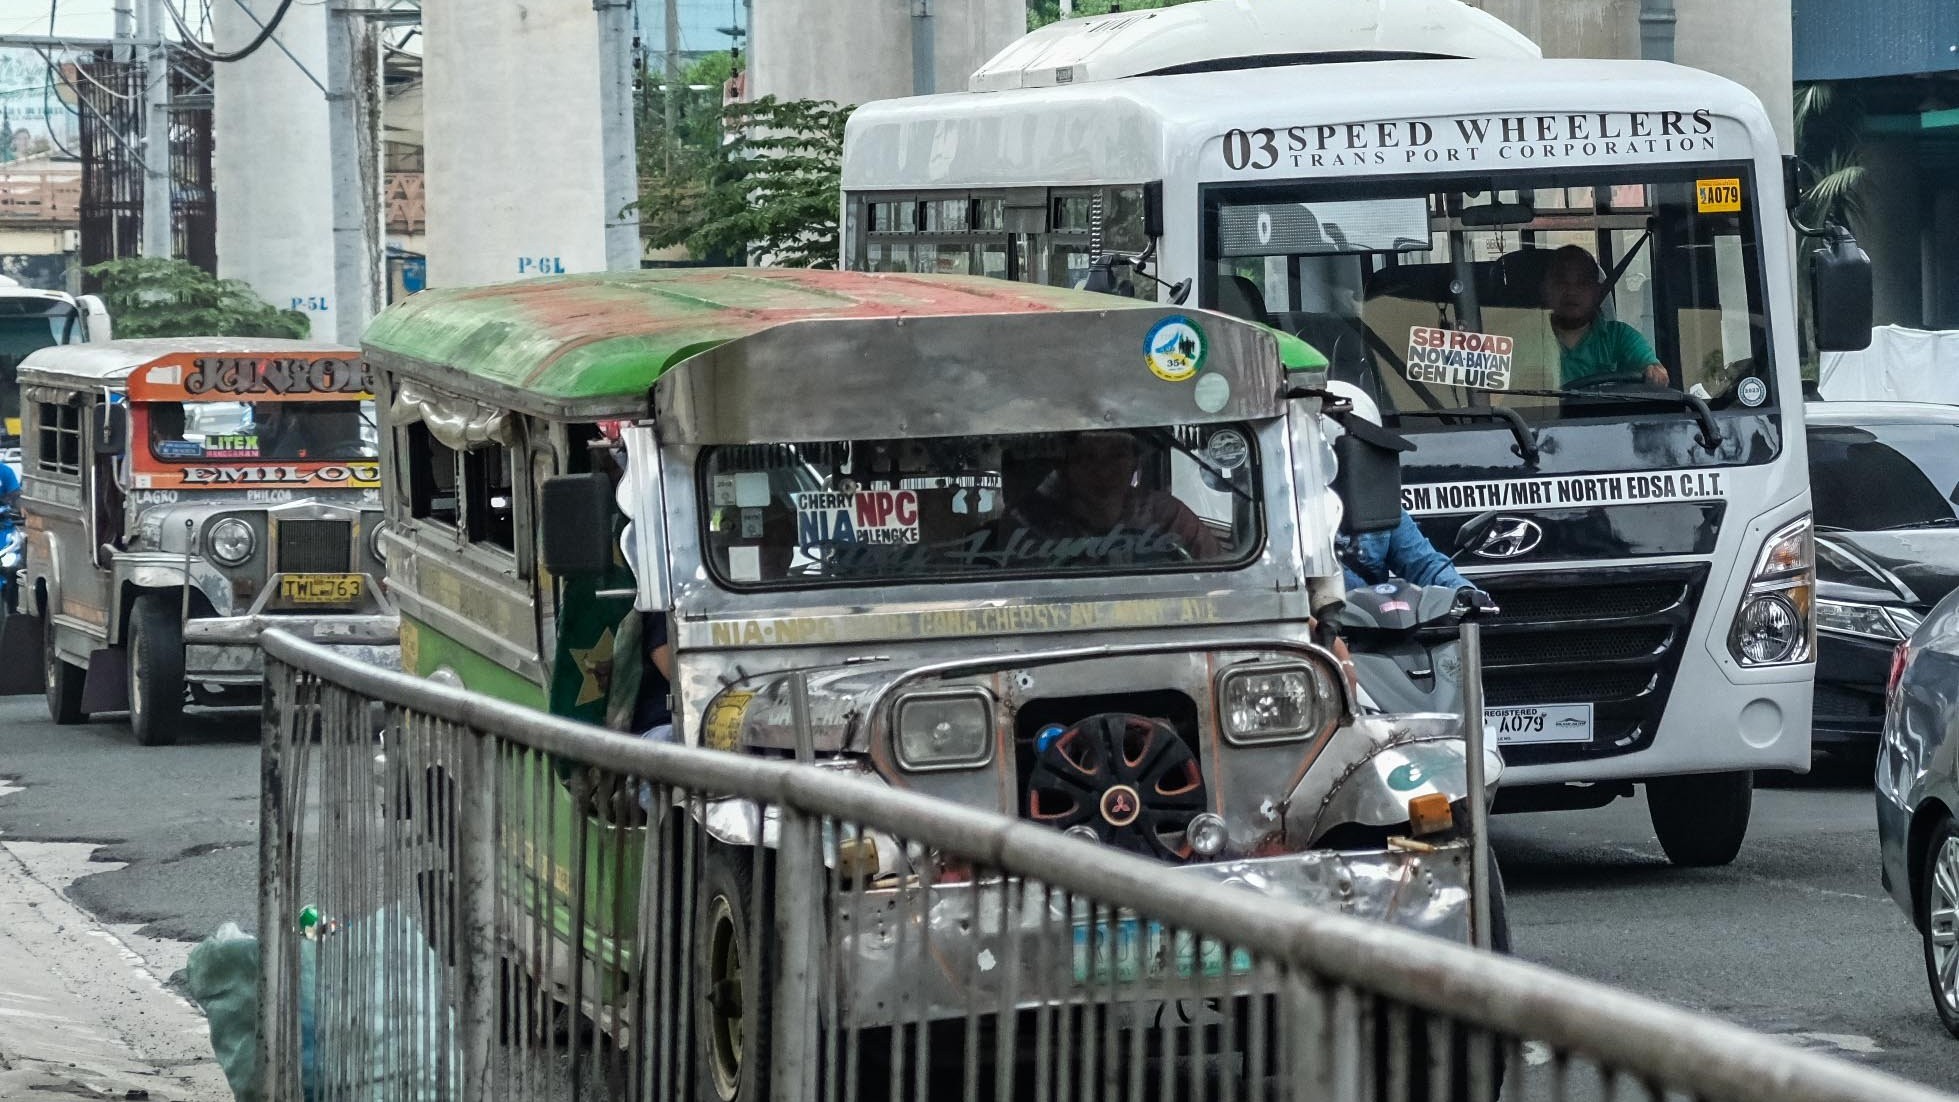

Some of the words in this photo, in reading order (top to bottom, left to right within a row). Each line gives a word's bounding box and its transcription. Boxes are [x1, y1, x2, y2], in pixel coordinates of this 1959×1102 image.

[1287, 121, 1433, 152] SPEED
[1454, 108, 1712, 145] WHEELERS
[1222, 127, 1279, 171] 03
[1290, 151, 1386, 168] TRANS
[1405, 147, 1479, 163] PORT
[1498, 136, 1715, 159] CORPORATION
[1707, 186, 1739, 204] A079
[517, 256, 565, 274] P-6L
[291, 297, 328, 311] P-5L
[1412, 328, 1445, 349] SB
[1449, 333, 1513, 356] ROAD
[1166, 359, 1186, 367] 354
[1408, 363, 1447, 383] GEN
[1452, 368, 1505, 389] LUIS
[205, 435, 259, 449] LITEX
[136, 490, 178, 504] LAGRO
[247, 489, 292, 502] PHILCOA
[1401, 487, 1432, 511] SM
[1435, 481, 1552, 509] NORTH/MRT
[1557, 477, 1623, 502] NORTH
[1626, 474, 1677, 499] EDSA
[1680, 472, 1724, 498] C.I.T.
[800, 493, 855, 509] CHERRY
[855, 491, 917, 528] NPC
[798, 509, 856, 545] NIA
[285, 580, 318, 596] TWL
[325, 580, 360, 596] 763
[1484, 708, 1538, 717] REGISTERED
[1499, 715, 1544, 733] A079
